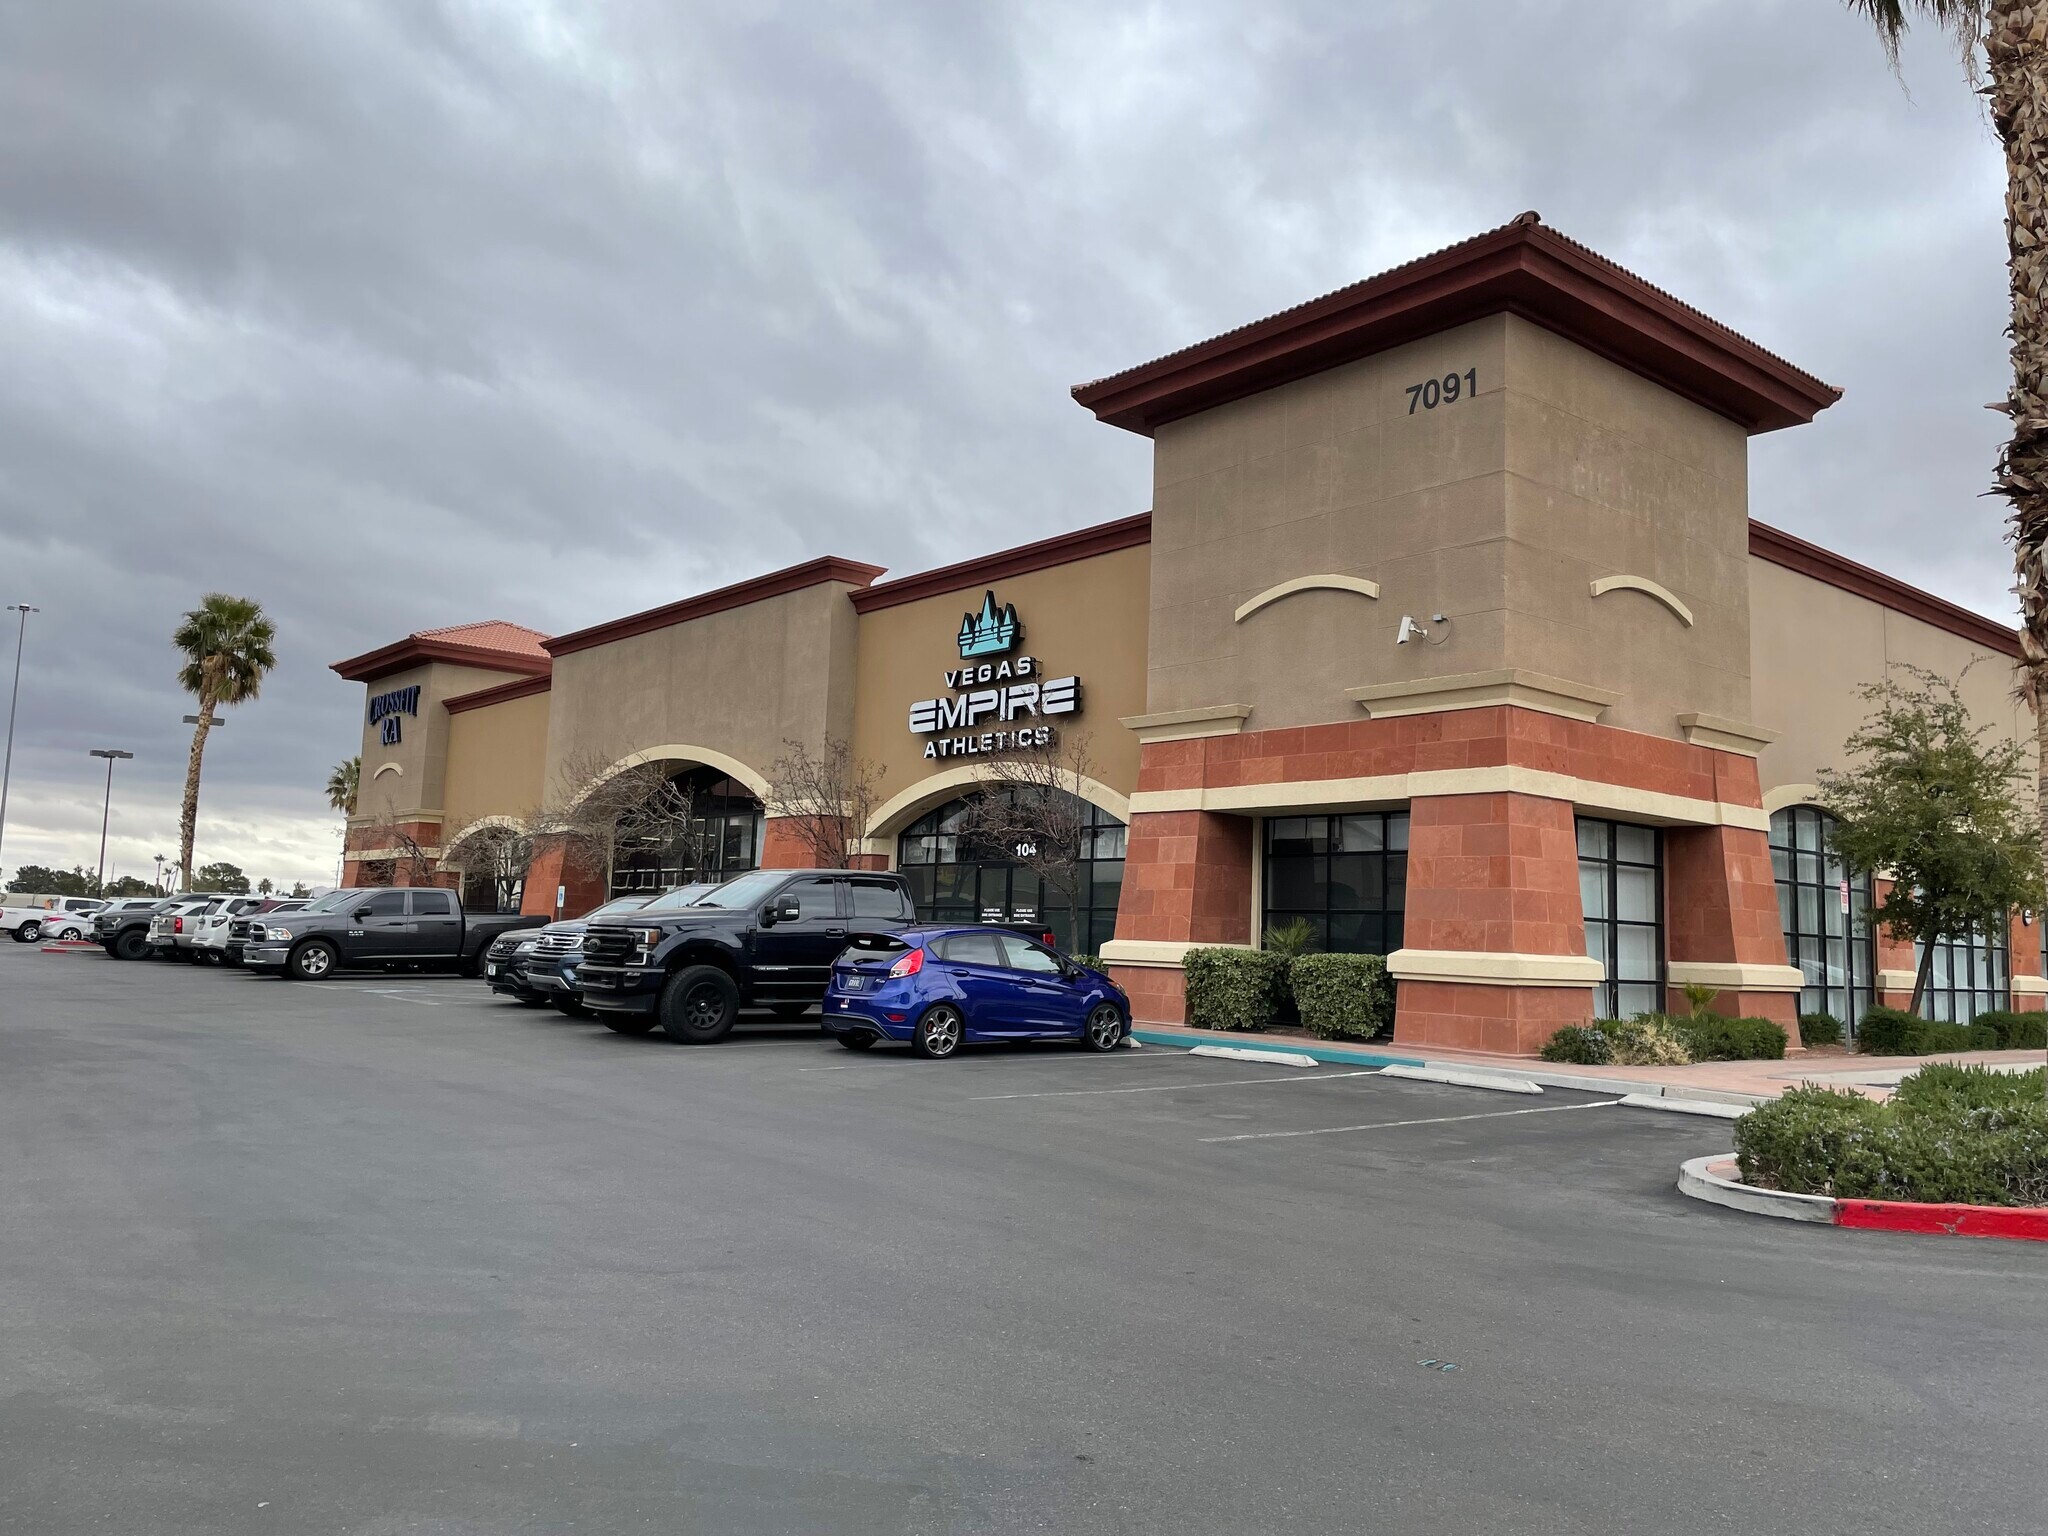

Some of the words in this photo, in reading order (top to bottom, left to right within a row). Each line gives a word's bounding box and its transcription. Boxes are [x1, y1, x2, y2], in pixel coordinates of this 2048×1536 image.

[1405, 367, 1476, 415] 7091
[943, 656, 1033, 688] VEGAS
[368, 685, 419, 726] CROSSFIT
[908, 676, 1077, 734] EMPIRE
[381, 716, 400, 745] RA
[923, 726, 1051, 759] ATHLETICS
[1015, 842, 1037, 857] 104
